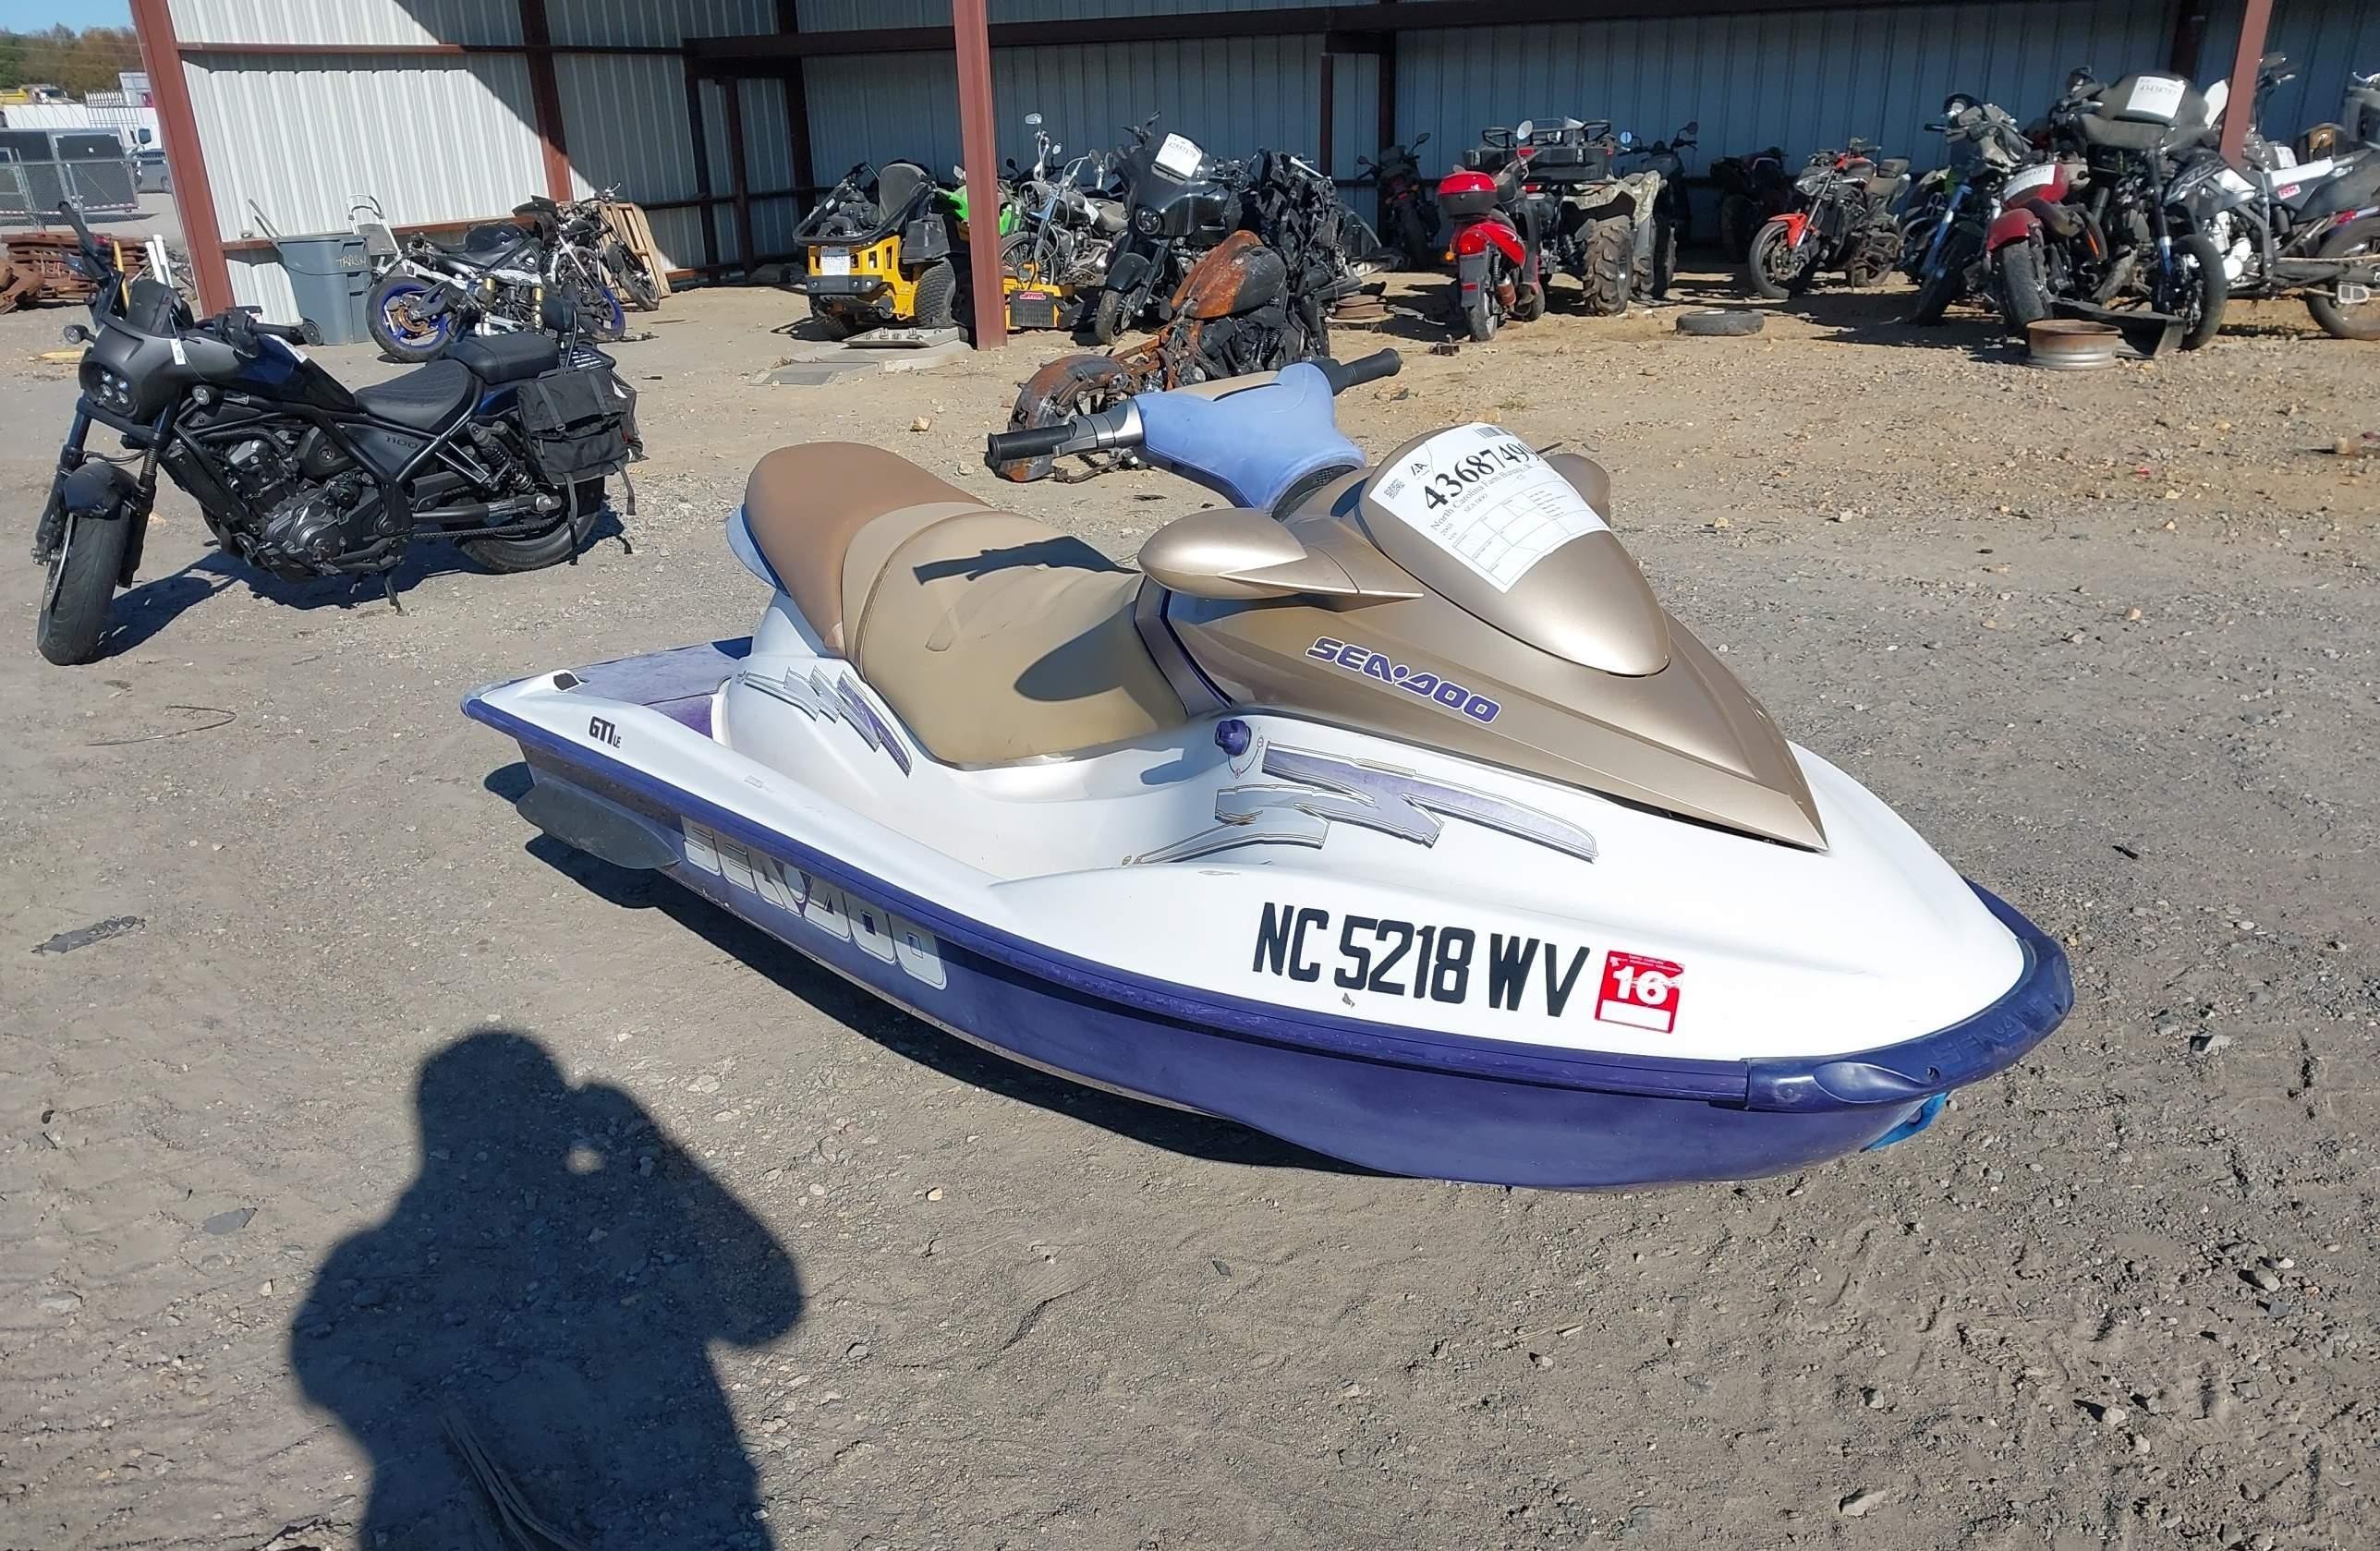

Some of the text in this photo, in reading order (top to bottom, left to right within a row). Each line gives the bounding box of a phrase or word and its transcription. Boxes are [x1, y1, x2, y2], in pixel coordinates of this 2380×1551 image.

[334, 254, 368, 269] TRASH
[1430, 508, 1454, 531] North
[1452, 483, 1485, 509] Carolina
[589, 716, 616, 745] GTI
[1252, 902, 1330, 983] NC
[1333, 914, 1476, 1005] 5218
[1611, 964, 1670, 1007] 16
